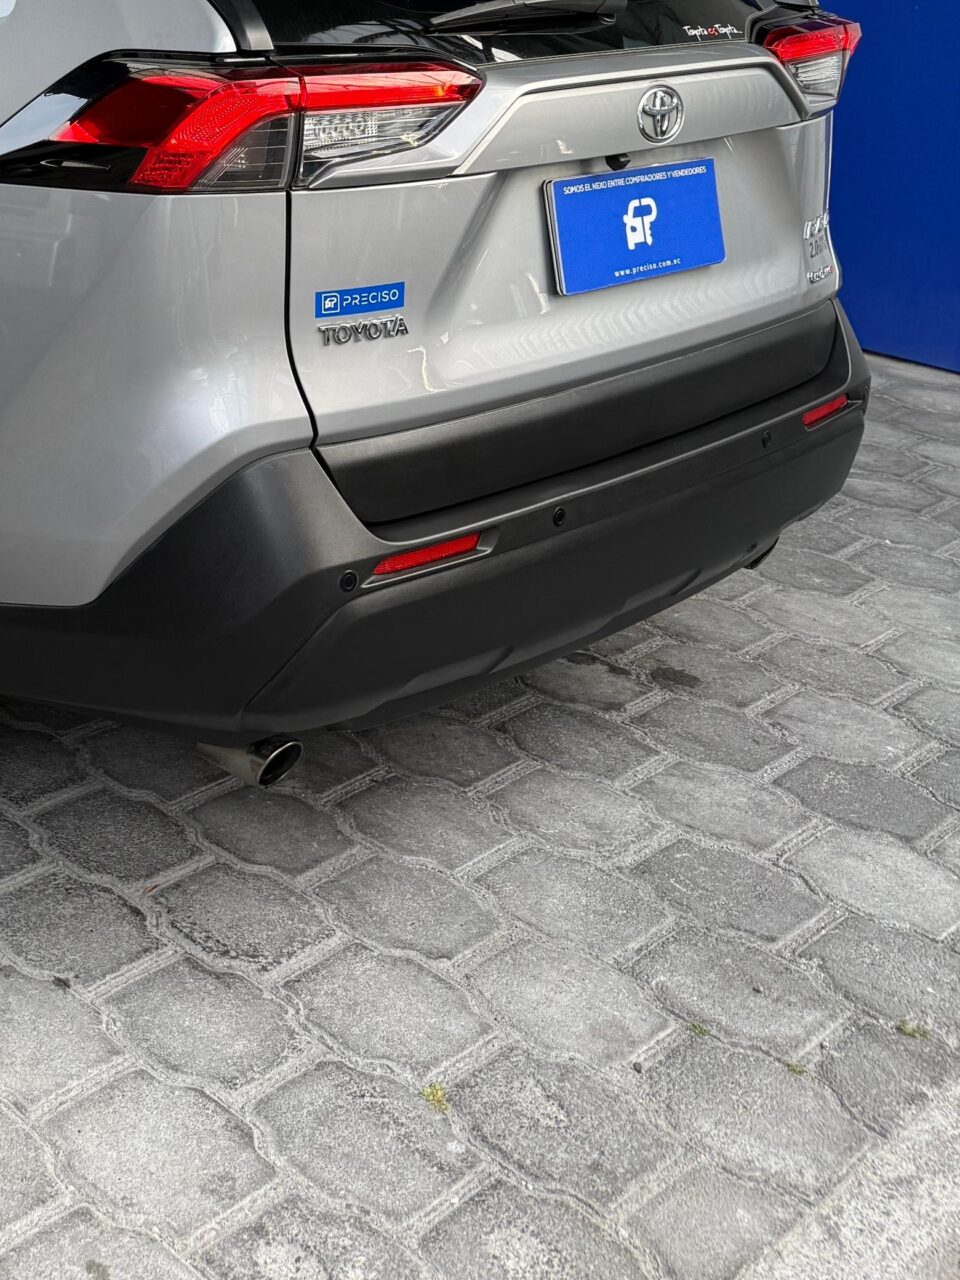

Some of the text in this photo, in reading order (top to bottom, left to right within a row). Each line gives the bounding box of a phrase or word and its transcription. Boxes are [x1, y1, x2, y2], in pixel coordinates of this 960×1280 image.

[563, 166, 707, 195] SOMOS EL NEXO ENTRE COMPRADORES Y VENDEDORES
[614, 258, 681, 277] www.preciso.com.ec
[343, 289, 399, 307] PRECISO
[318, 314, 409, 346] TOYOTA
